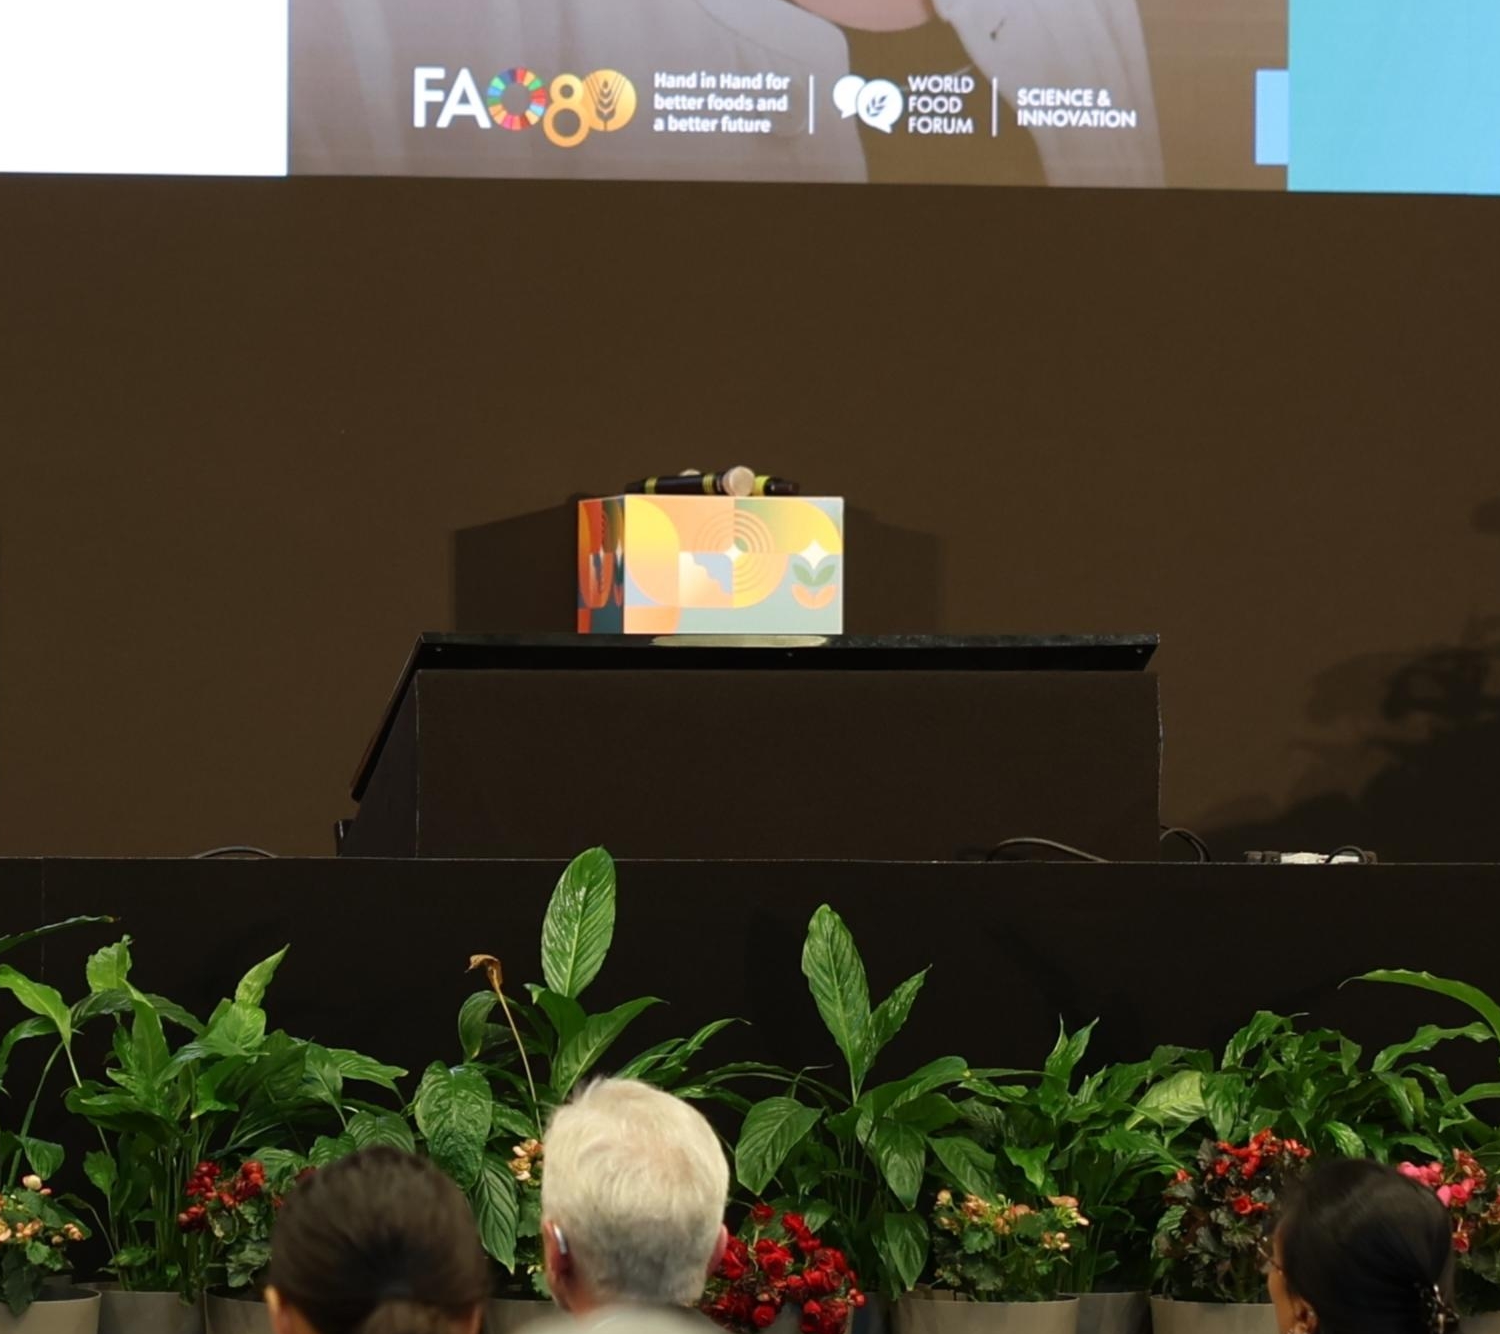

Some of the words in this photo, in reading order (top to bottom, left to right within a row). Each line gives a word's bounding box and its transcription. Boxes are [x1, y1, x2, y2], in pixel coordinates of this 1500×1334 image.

[653, 71, 696, 90] Hand
[700, 72, 715, 90] in
[719, 72, 761, 91] Hand
[765, 73, 791, 91] for
[908, 74, 974, 94] WORLD
[653, 93, 704, 113] better
[707, 94, 753, 112] foods
[756, 94, 788, 112] and
[908, 95, 963, 114] FOOD
[1016, 88, 1093, 107] SCIENCE
[1097, 89, 1111, 107] &
[653, 119, 663, 133] a
[667, 114, 717, 133] better
[720, 114, 772, 133] future
[908, 116, 973, 135] FORUM
[1016, 109, 1137, 129] INNOVATION
